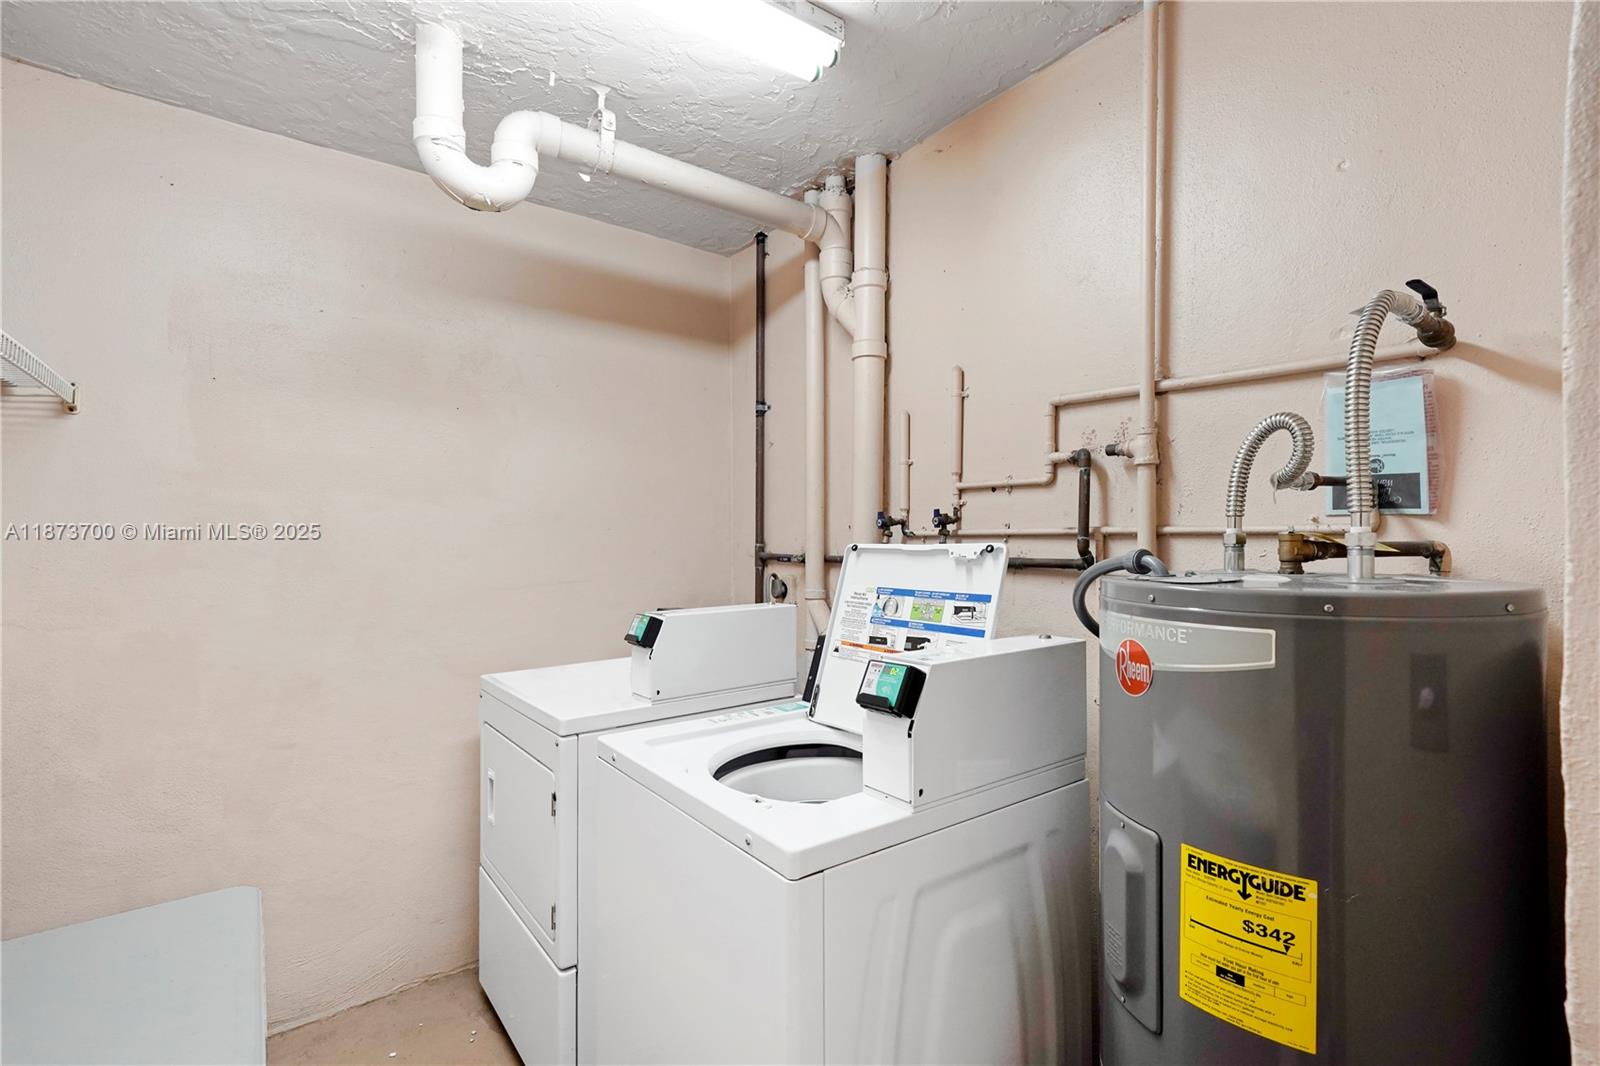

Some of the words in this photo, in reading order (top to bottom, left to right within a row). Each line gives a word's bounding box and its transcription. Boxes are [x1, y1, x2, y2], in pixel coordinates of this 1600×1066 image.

[1118, 640, 1151, 686] Rheem
[1187, 852, 1306, 902] ENERGYGUIDE
[1242, 919, 1296, 947] $342
